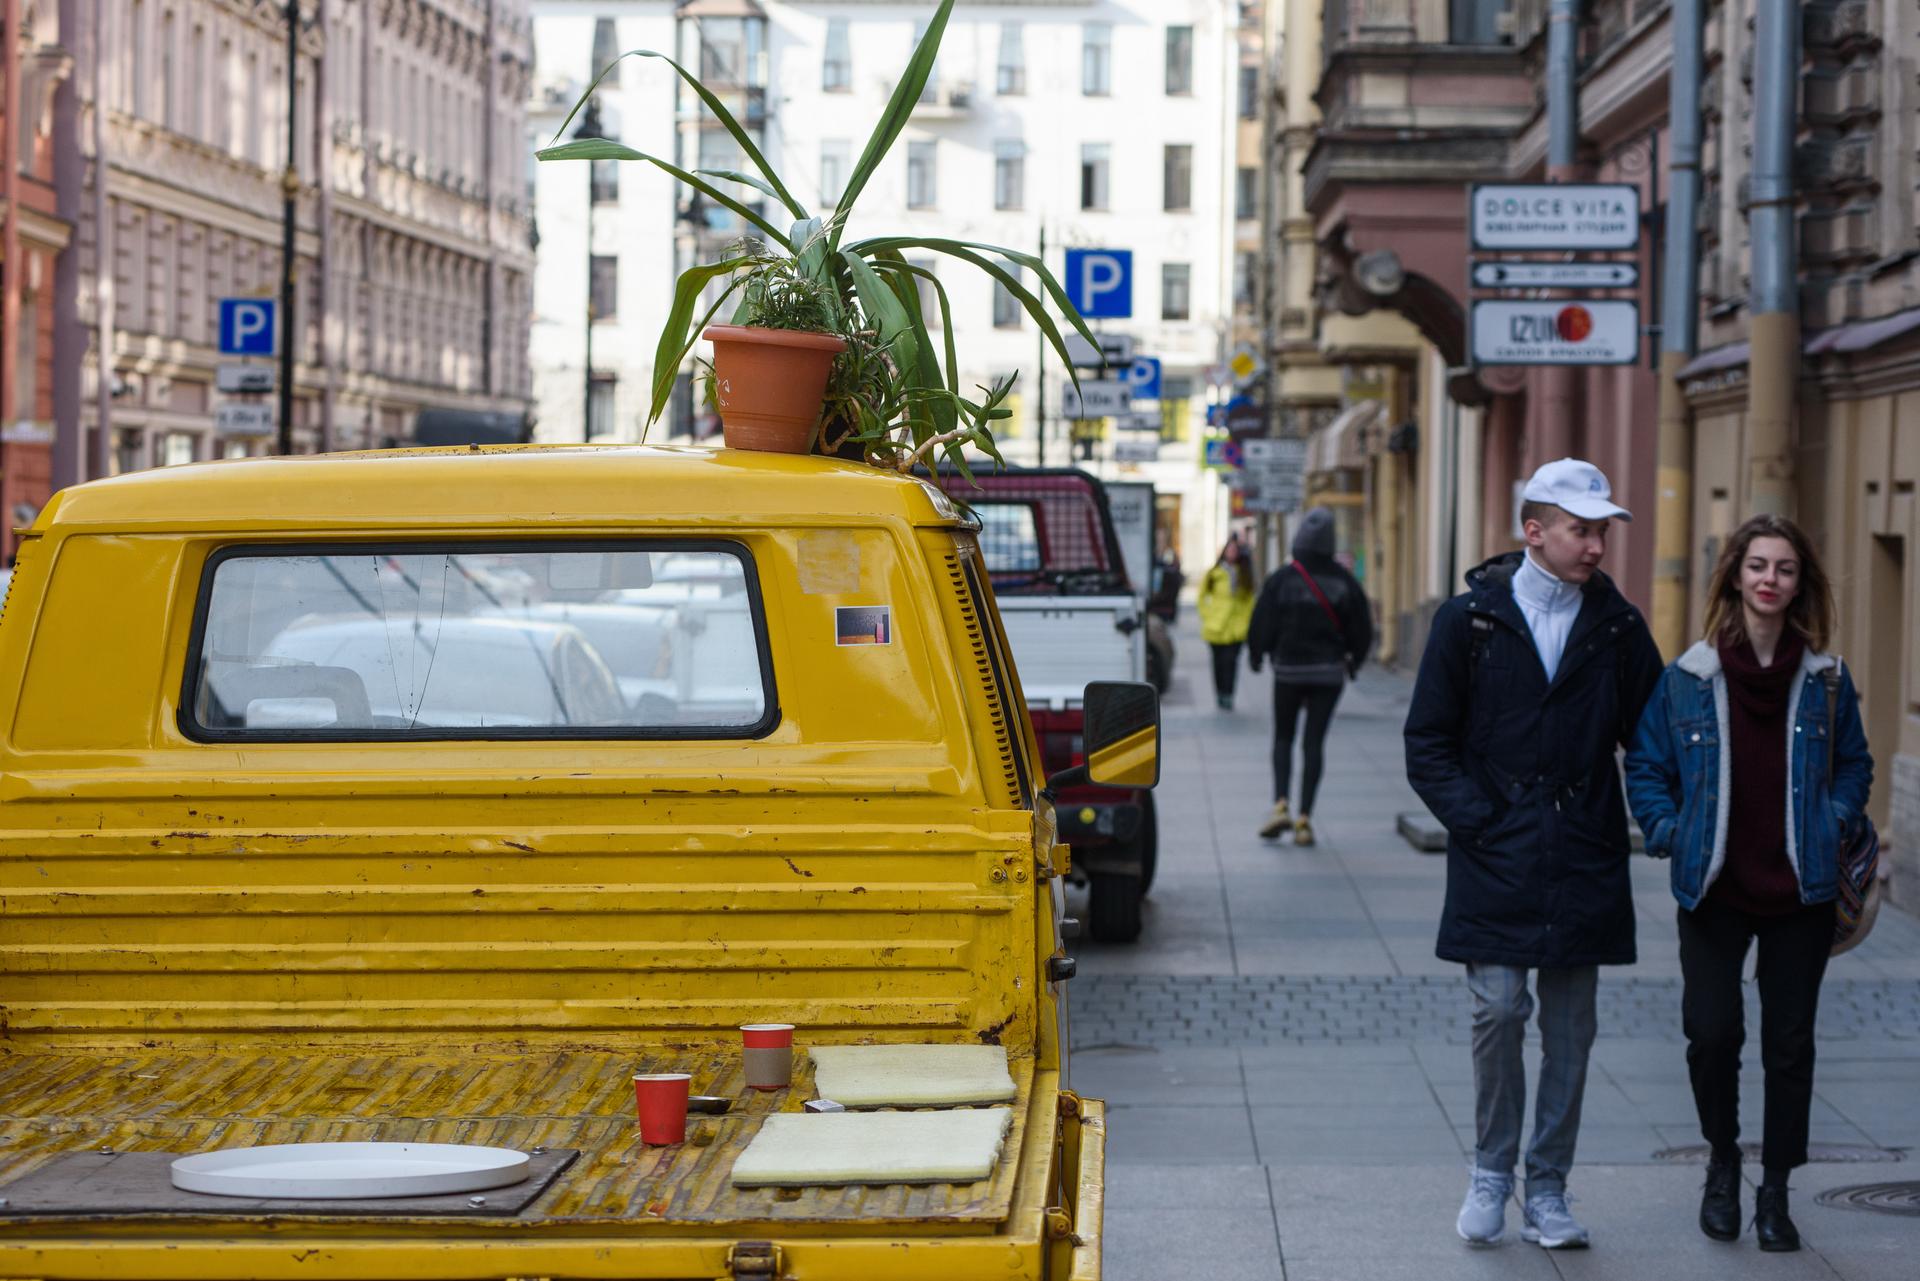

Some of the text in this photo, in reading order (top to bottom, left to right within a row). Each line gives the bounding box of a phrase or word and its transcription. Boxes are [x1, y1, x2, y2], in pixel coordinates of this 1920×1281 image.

[1485, 198, 1625, 217] DOLCE VITA
[1082, 254, 1123, 313] P
[234, 304, 266, 350] P
